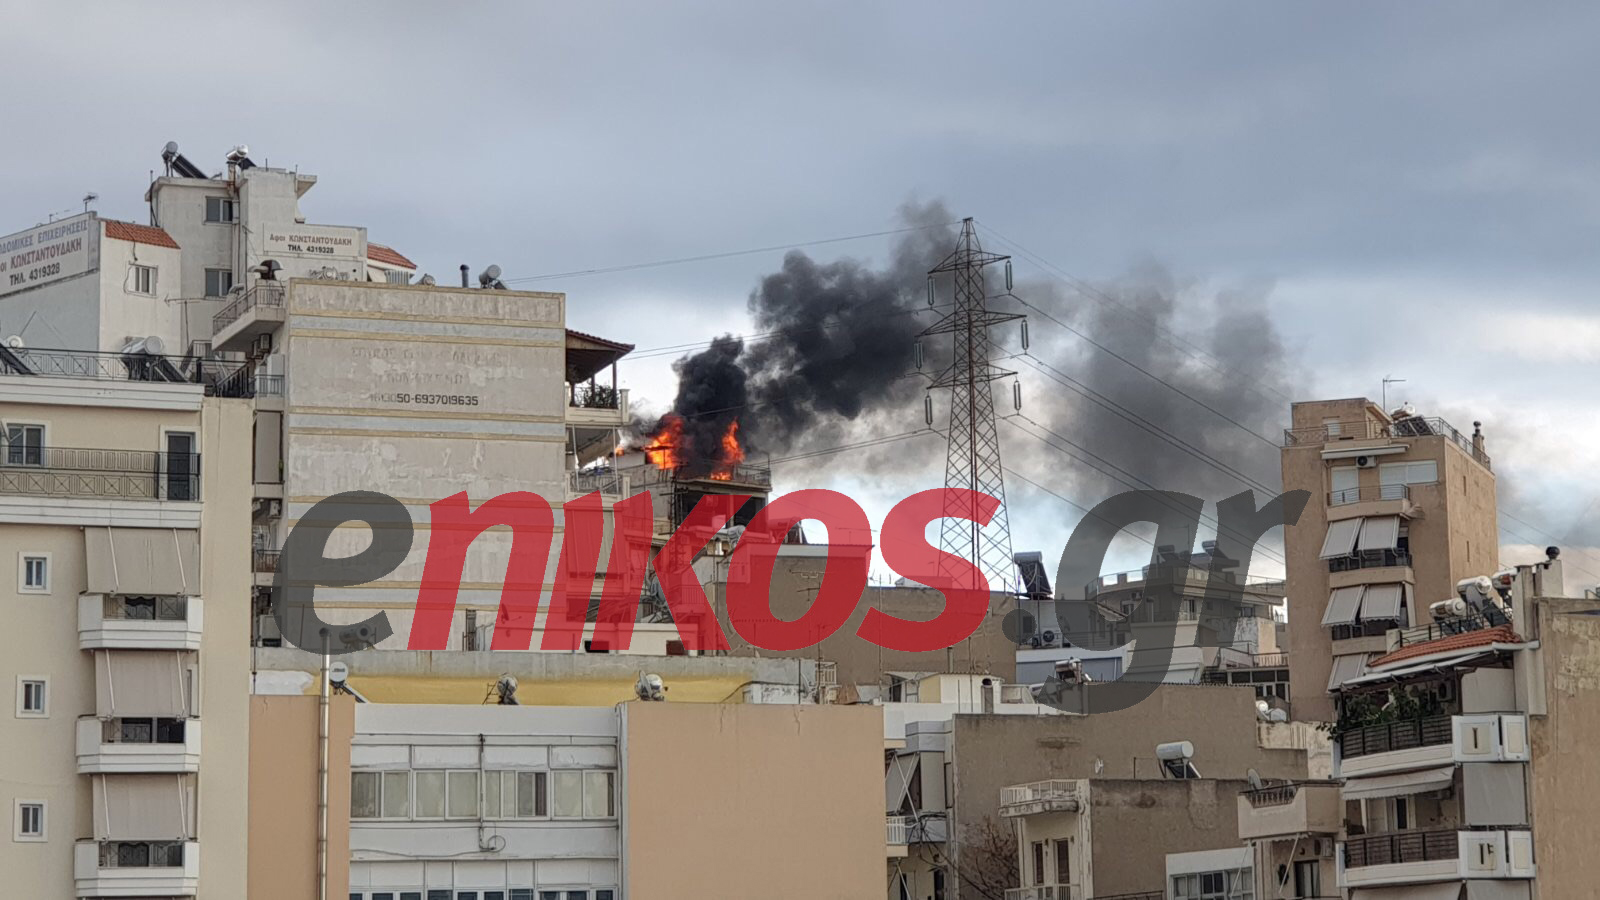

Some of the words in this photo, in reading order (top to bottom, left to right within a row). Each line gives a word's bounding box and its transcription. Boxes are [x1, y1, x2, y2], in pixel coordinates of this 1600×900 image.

[0, 234, 34, 254] ΔΟΜΙΚΕΣ
[38, 220, 88, 244] ΕΠΙΧΕΙΡΗΣΕΙΣ
[289, 234, 352, 246] ΚΩΝΣΤΑΝΤΟΥΔΑΚΗ
[10, 237, 82, 269] ΚΩΝΣΤΑΝΤΟΥΔΑΚΗ
[306, 245, 335, 254] 4319328
[29, 262, 61, 281] 4319328
